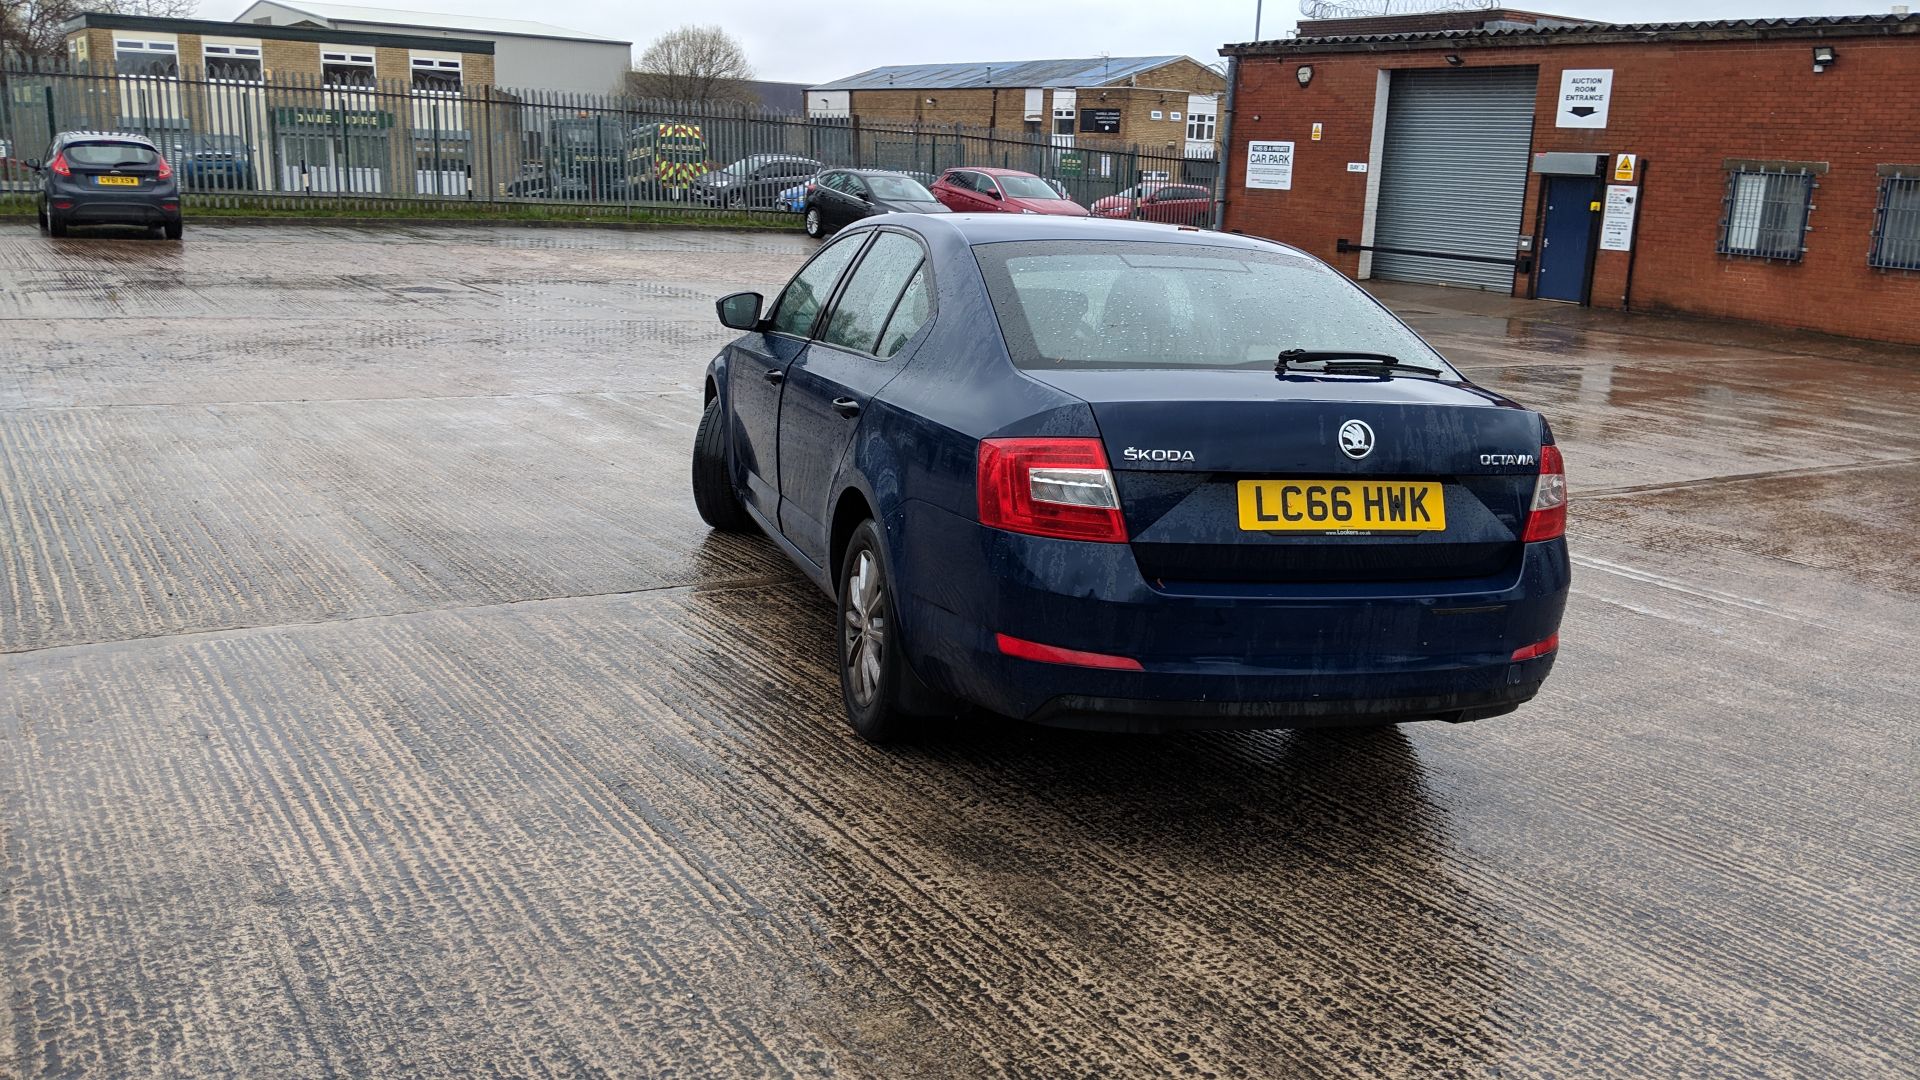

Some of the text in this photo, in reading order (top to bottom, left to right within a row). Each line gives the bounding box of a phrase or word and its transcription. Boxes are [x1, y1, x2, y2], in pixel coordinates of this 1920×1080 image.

[1250, 153, 1290, 164] CAR PARK
[1123, 446, 1196, 462] ŠKODA
[1480, 454, 1535, 466] OCTAVIA
[1255, 485, 1431, 522] LC66 HWK
